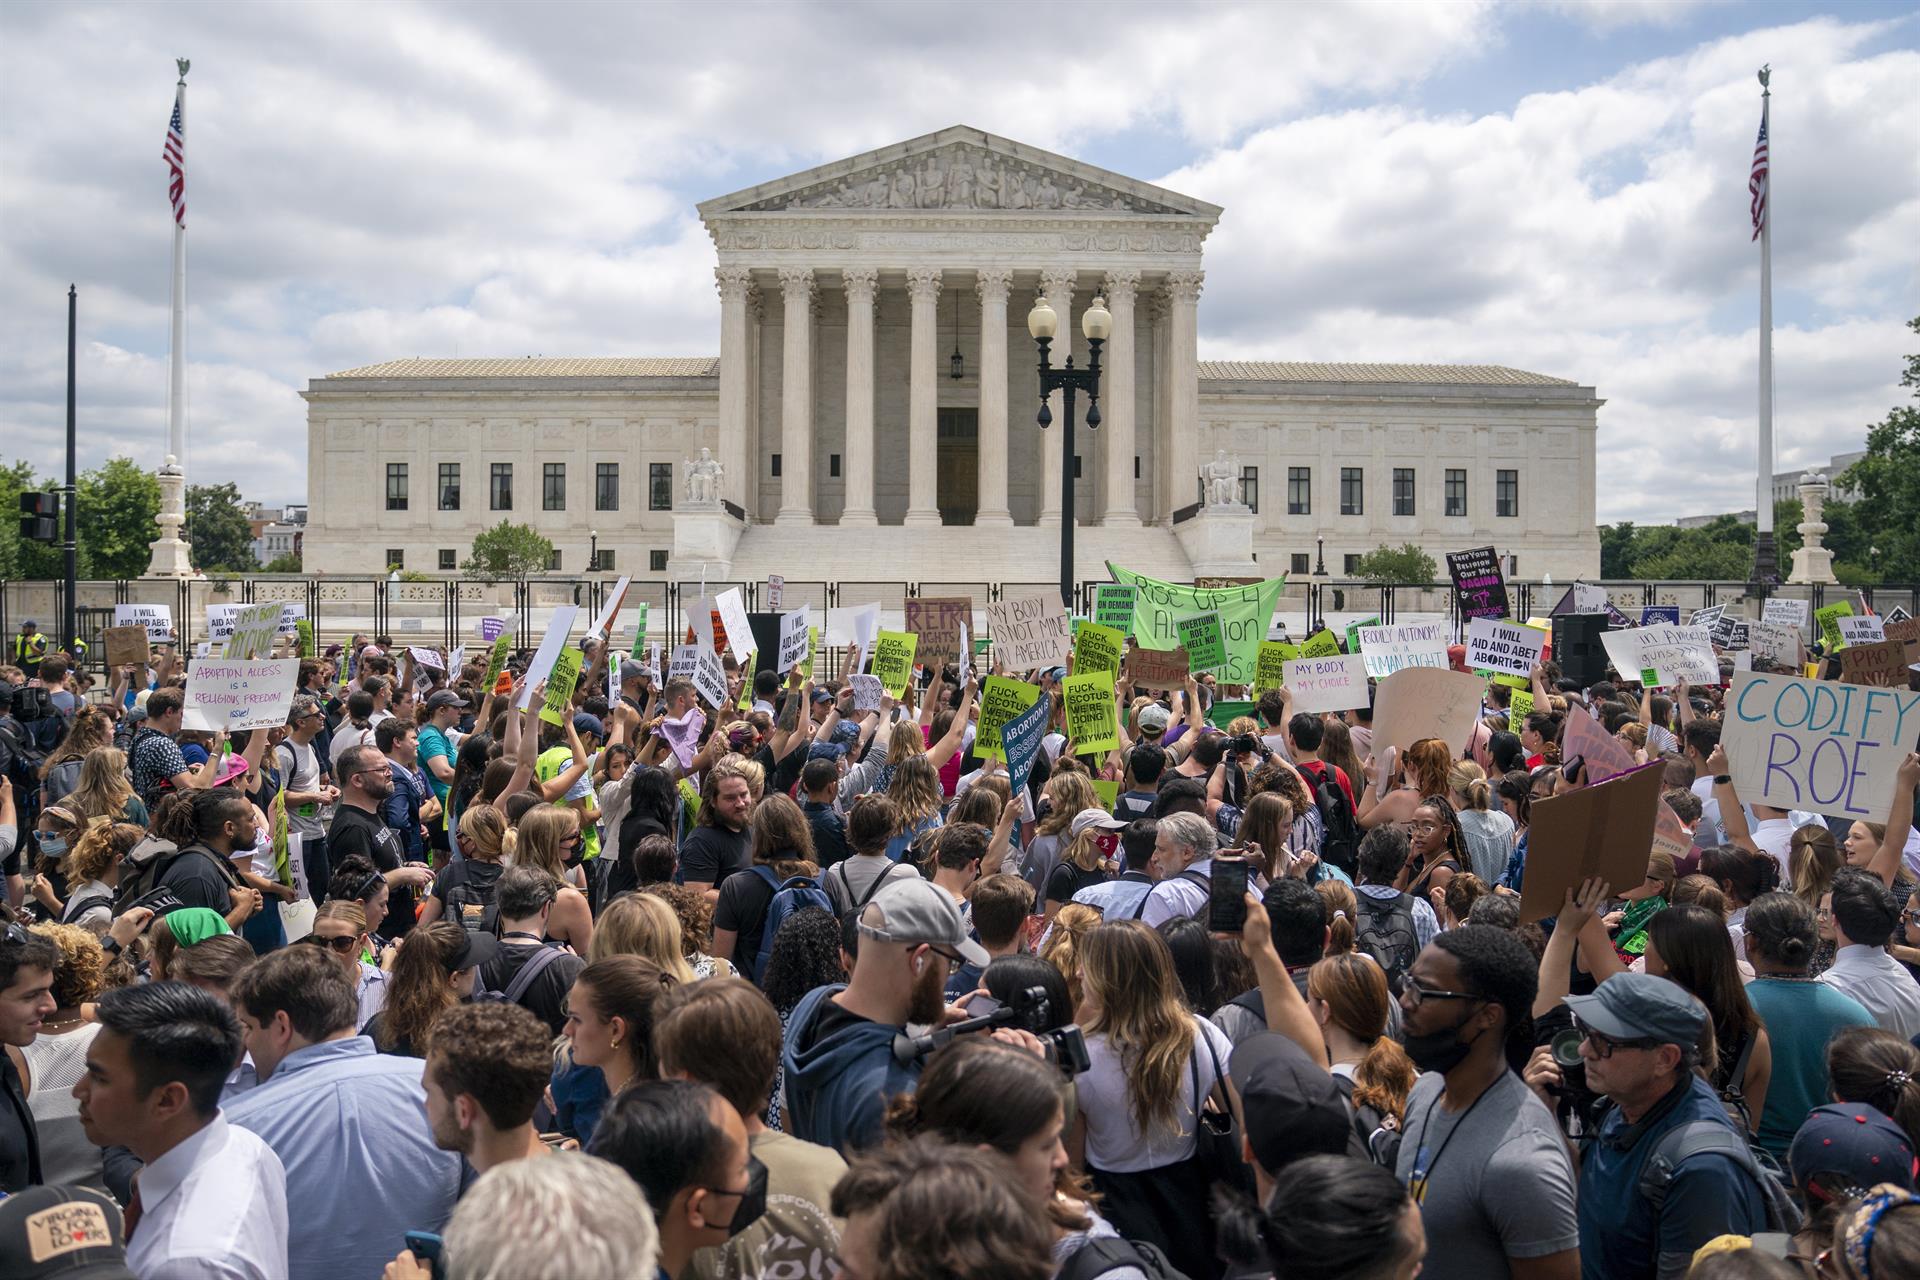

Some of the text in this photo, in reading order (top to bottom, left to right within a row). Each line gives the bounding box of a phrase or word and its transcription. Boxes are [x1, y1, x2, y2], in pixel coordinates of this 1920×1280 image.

[1459, 575, 1499, 589] VAGINA
[1102, 588, 1131, 598] ABORTION
[1135, 576, 1184, 608] Rise
[1242, 587, 1260, 616] 4
[1461, 591, 1469, 599] &
[987, 598, 1044, 624] MY BODY
[1097, 601, 1133, 609] ON DEMAND
[139, 608, 156, 617] WILL
[1105, 613, 1131, 621] WITHOUT
[211, 619, 224, 627] AID
[795, 614, 804, 629] WILL
[1180, 615, 1216, 630] OVERTURN
[1853, 620, 1872, 629] I WILL
[992, 614, 1070, 643] IS NOT MINE
[1190, 628, 1203, 639] ROE
[1363, 624, 1440, 644] BODILY AUTONOMY
[1845, 631, 1856, 639] AID
[1858, 631, 1869, 639] AND
[781, 637, 792, 651] AID
[792, 632, 801, 646] AND
[1083, 630, 1107, 643] FUCK
[1492, 628, 1521, 643] I WILL
[881, 638, 904, 648] FUCK
[1081, 639, 1117, 655] SCOTUS
[1187, 636, 1217, 649] HELL NO!
[1304, 642, 1321, 656] FUCK
[1472, 638, 1538, 659] AID AND ABET
[681, 649, 696, 659] I WILL
[880, 647, 911, 657] SCOTUS
[997, 647, 1012, 666] IN
[1015, 640, 1061, 664] AMERICA
[1080, 648, 1109, 661] WE'RE
[1262, 648, 1283, 656] FUCK
[1641, 647, 1673, 667] guns
[1852, 648, 1889, 667] PRO
[671, 661, 689, 671] AID AND
[877, 663, 901, 673] DOING
[1080, 658, 1106, 671] DOING
[1366, 652, 1442, 674] HUMAN RIGHT
[1474, 652, 1530, 671] ABORTION
[195, 664, 281, 680] ABORTION ACCESS
[699, 656, 708, 670] AID
[708, 665, 718, 681] AND
[1296, 664, 1312, 675] MY
[1068, 683, 1095, 693] FUCK
[1298, 677, 1350, 690] MY CHOICE
[195, 692, 281, 705] RELIGIOUS FREEDOM
[990, 686, 1018, 699] FUCK
[1070, 691, 1109, 704] SCOTUS
[988, 697, 1030, 712] SCOTUS
[1515, 696, 1535, 707] FUCK
[1071, 703, 1102, 714] WE'RE
[1737, 679, 1920, 746] CODIFY
[1006, 699, 1049, 743] ABORTION IS
[1073, 713, 1103, 724] DOING
[982, 728, 991, 737] IT
[1074, 726, 1083, 734] IT
[1076, 731, 1113, 745] ANYWAY
[1764, 733, 1880, 814] ROE
[33, 1207, 100, 1229] VIRGINIA
[50, 1218, 95, 1236] IS FOR
